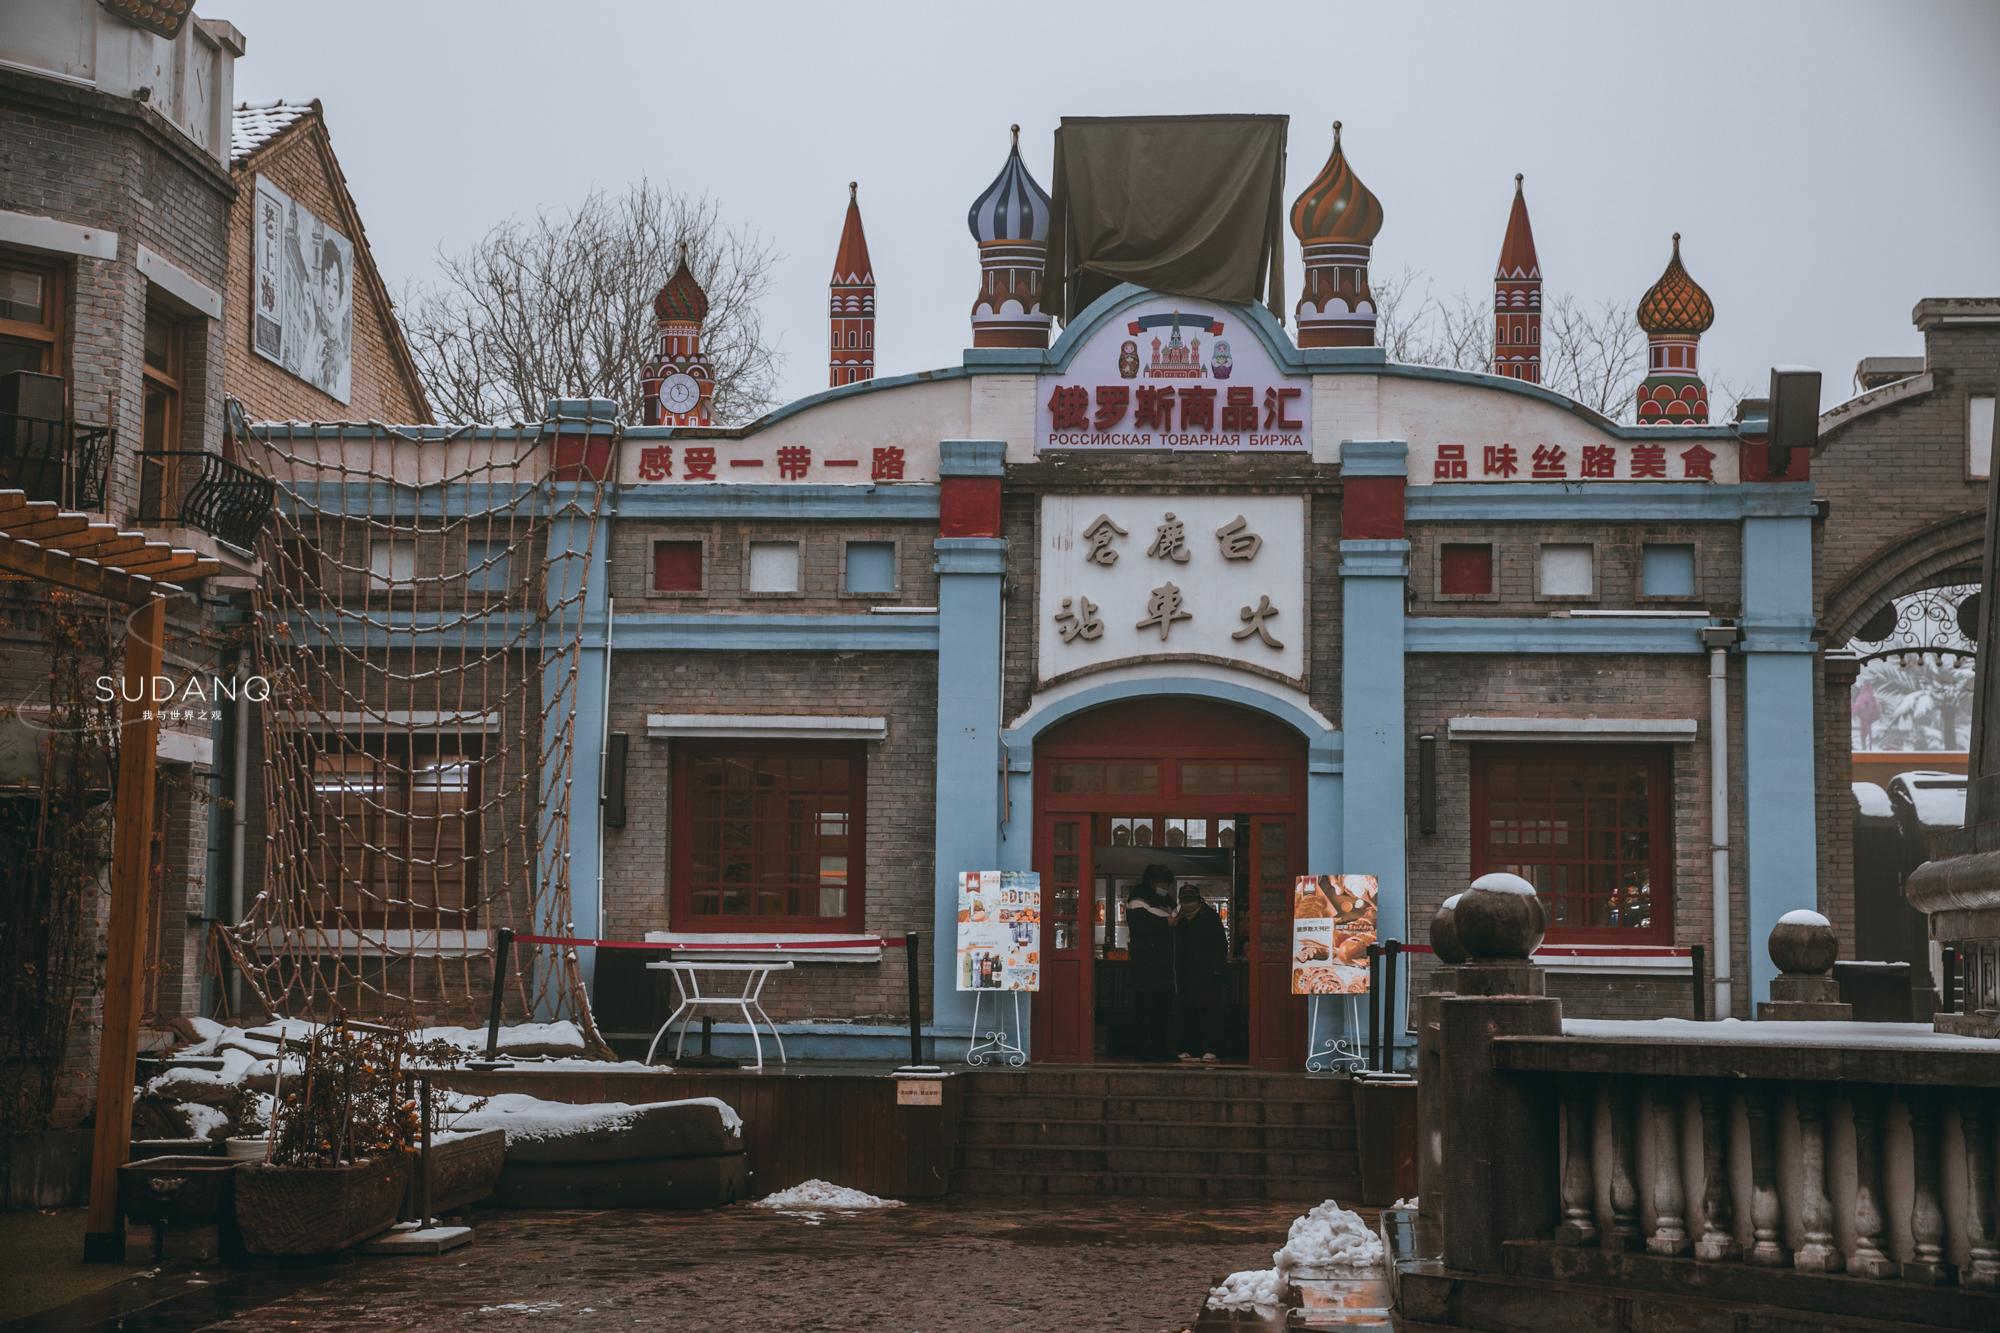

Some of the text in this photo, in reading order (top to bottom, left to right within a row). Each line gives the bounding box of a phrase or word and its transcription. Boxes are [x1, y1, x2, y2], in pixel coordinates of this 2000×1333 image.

[261, 202, 276, 313] 老上海
[1047, 384, 1303, 432] 俄罗斯商品汇
[1049, 432, 1303, 446] РОССИЙСКАЯ ТОВАРНАЯ БИРЖА
[638, 445, 906, 481] 感受一带一路
[1434, 443, 1717, 480] 品味丝路美食
